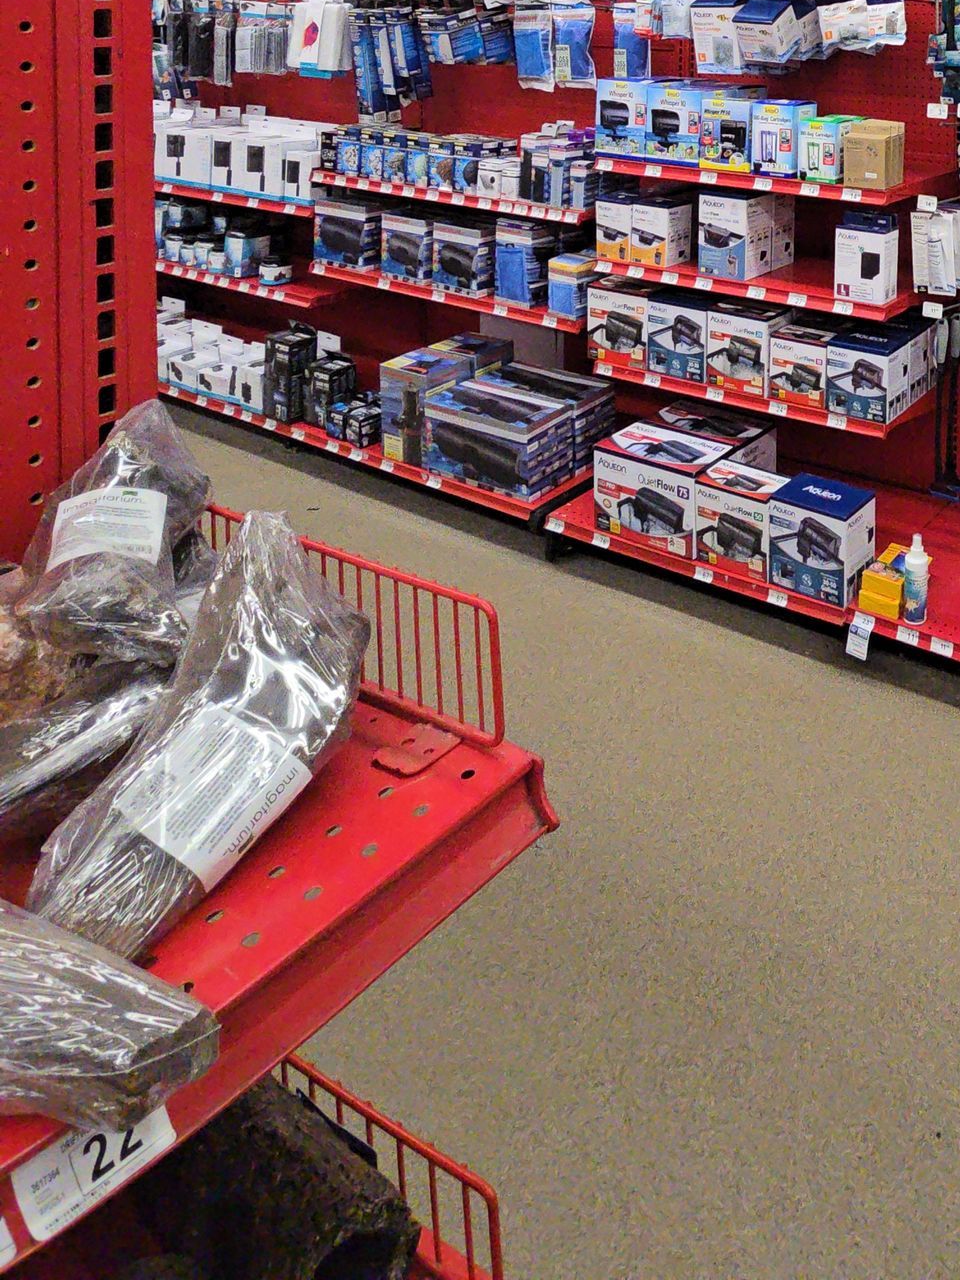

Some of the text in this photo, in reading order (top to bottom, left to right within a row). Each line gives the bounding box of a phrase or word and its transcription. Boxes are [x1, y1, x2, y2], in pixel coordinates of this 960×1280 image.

[637, 473, 689, 499] QuietFlow 75
[723, 502, 753, 518] QuietFlow
[226, 767, 300, 855] imagitarium
